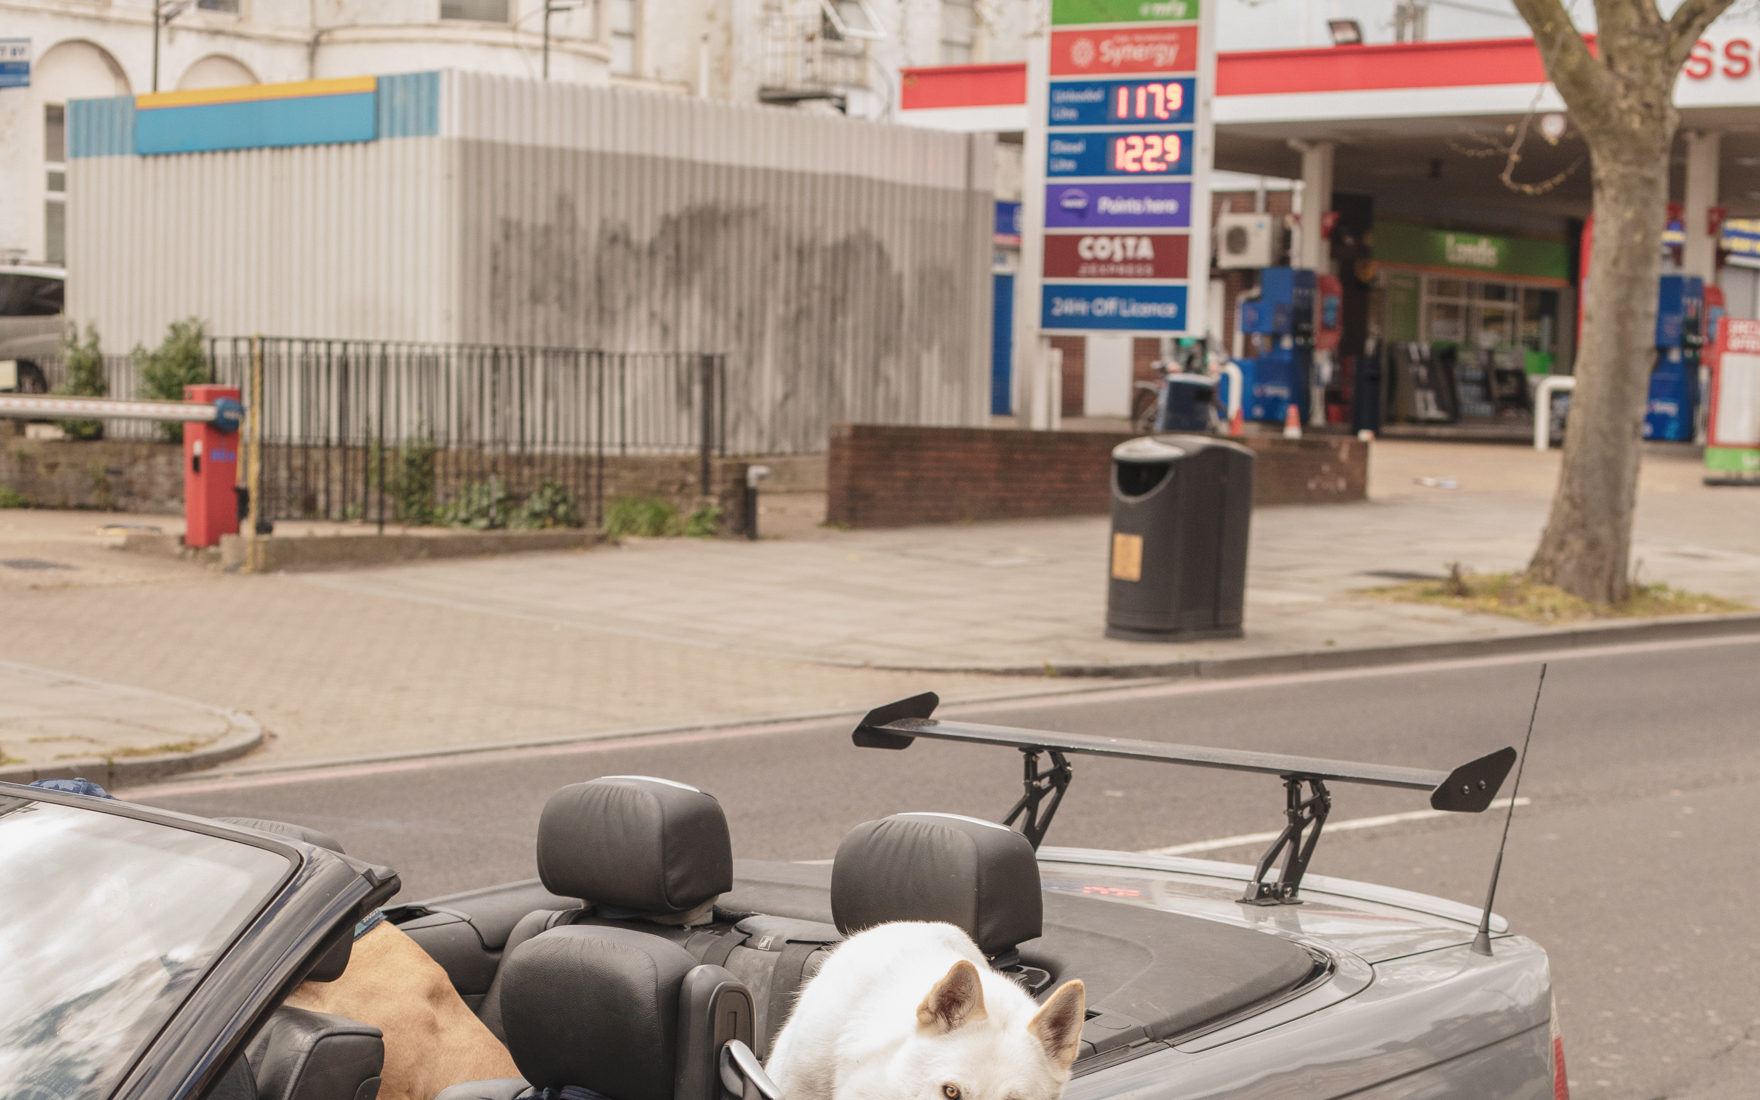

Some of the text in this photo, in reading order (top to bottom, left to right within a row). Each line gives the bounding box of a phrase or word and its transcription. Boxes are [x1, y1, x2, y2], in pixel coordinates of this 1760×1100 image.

[1099, 38, 1180, 68] Synergy
[1684, 38, 1760, 80] SS
[1077, 235, 1155, 262] COSTA
[1091, 297, 1118, 317] Off
[1119, 298, 1179, 318] Licence
